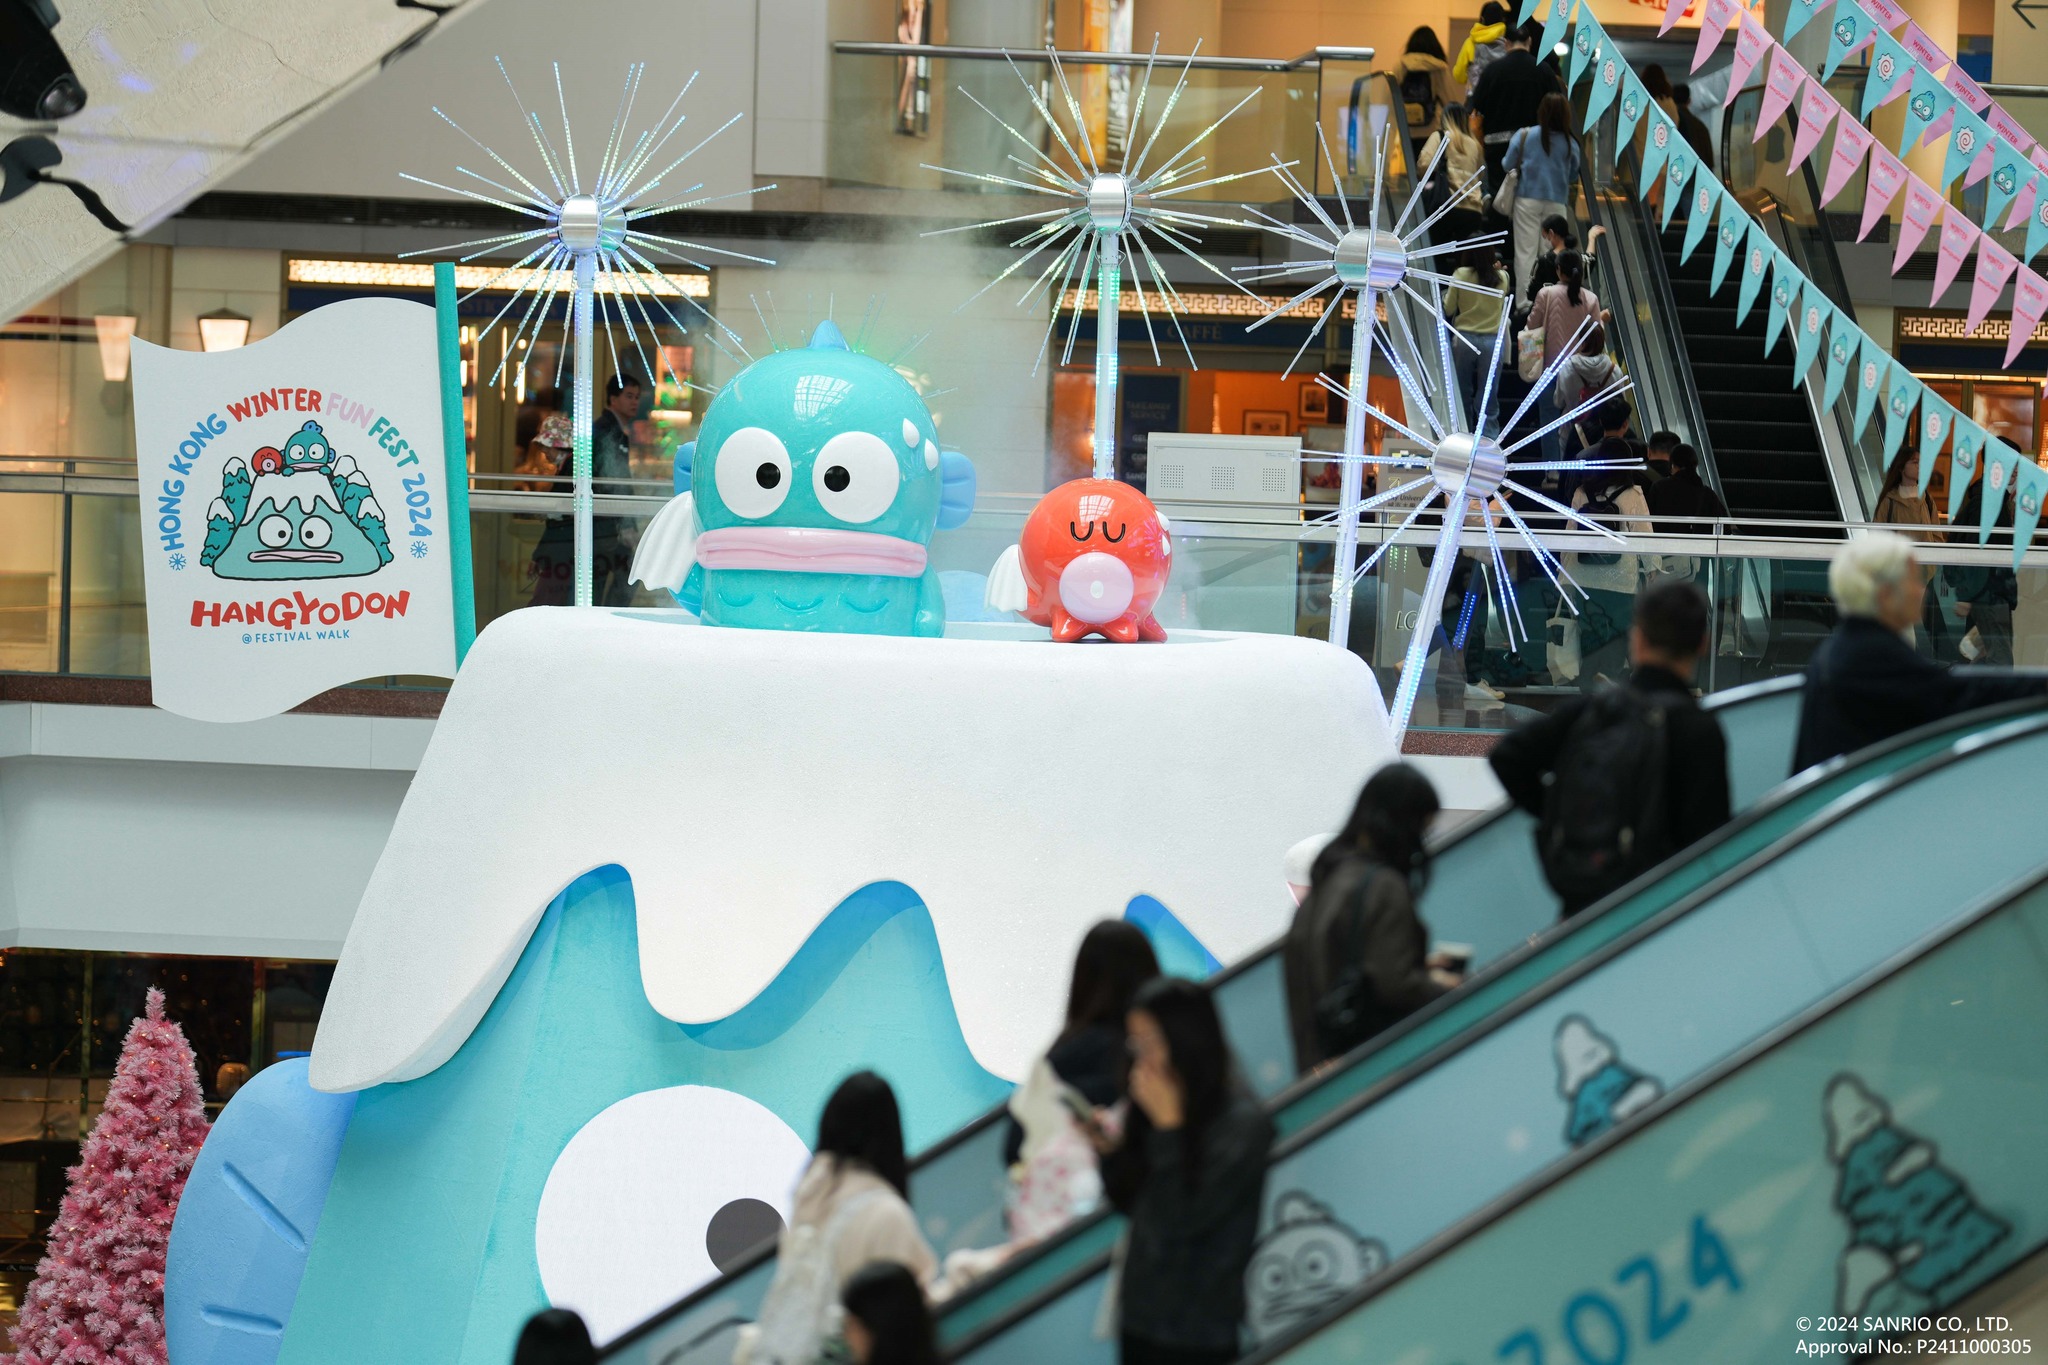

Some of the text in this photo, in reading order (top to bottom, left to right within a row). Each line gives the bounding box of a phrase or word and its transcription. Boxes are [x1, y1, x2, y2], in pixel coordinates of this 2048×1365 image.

[1913, 39, 1933, 62] WINTER
[1955, 80, 1976, 104] WINTER
[1997, 121, 2018, 145] WINTER
[158, 387, 433, 552] HONG KONG WINTER FUN FEST 2024
[190, 589, 410, 630] HANGYODON
[241, 628, 350, 644] @ FESTIVAL WALK
